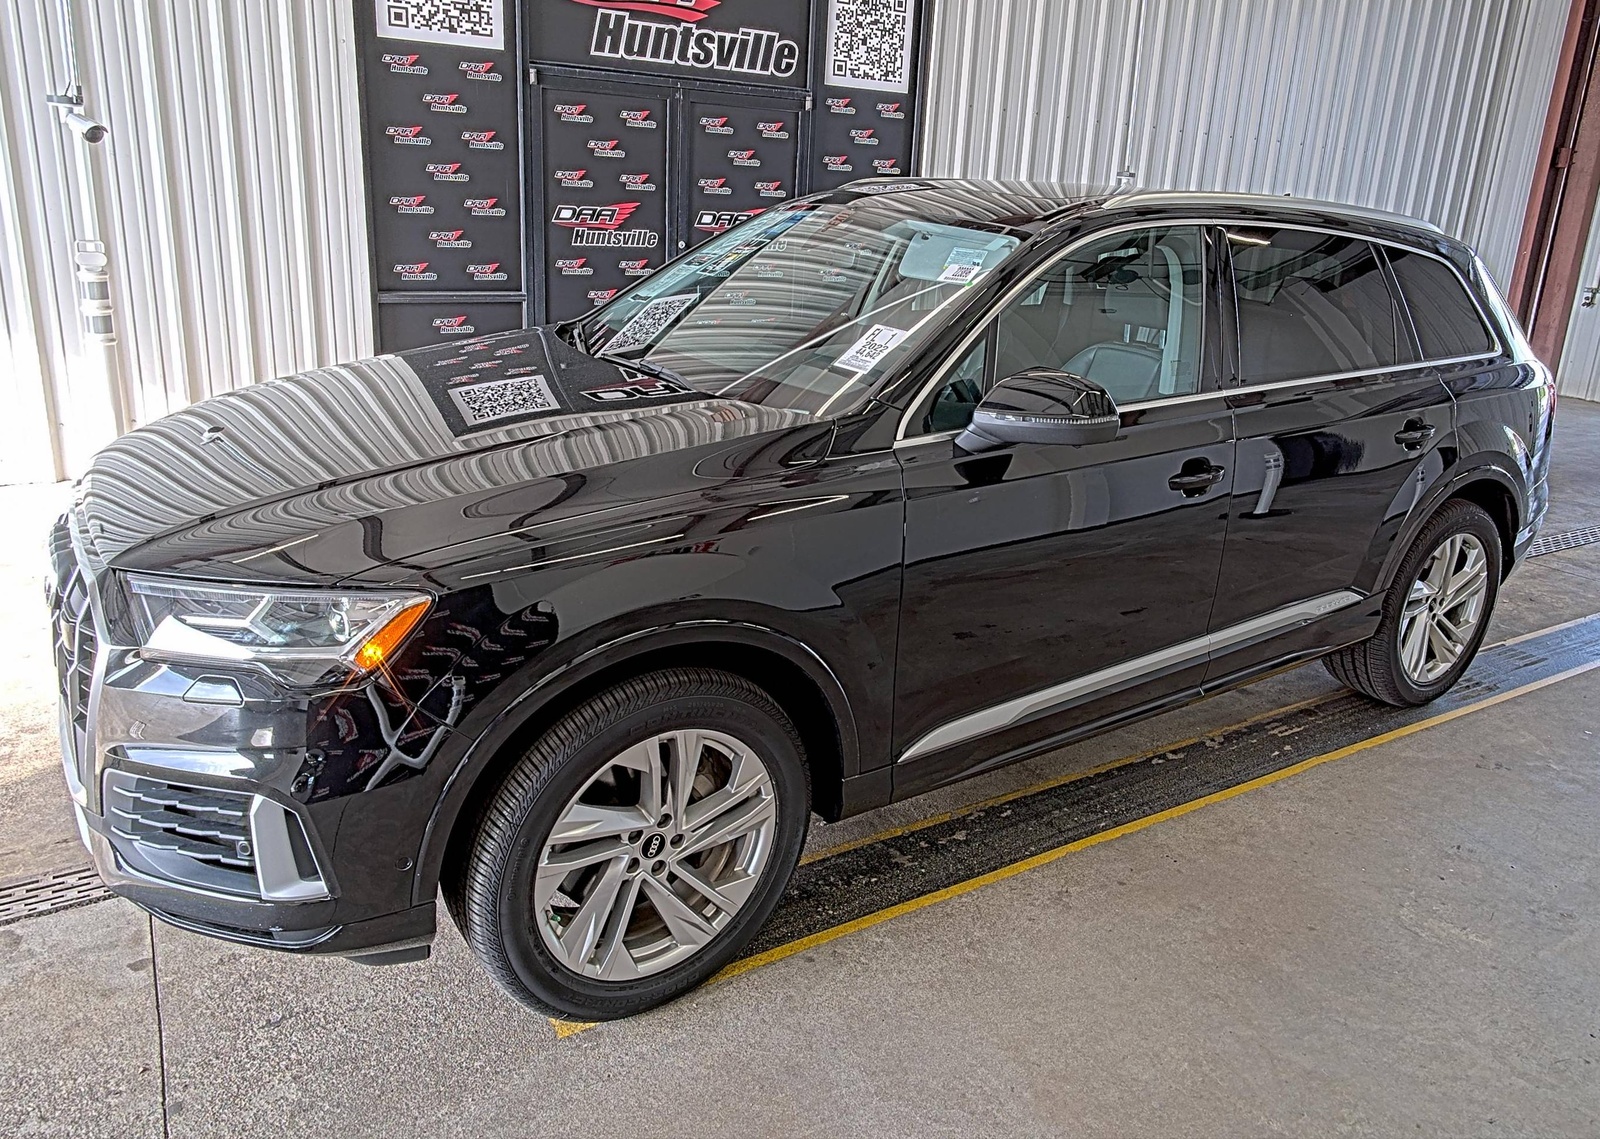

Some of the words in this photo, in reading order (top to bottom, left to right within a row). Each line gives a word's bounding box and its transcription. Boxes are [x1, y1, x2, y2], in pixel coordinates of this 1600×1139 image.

[590, 8, 799, 77] Huntsville
[551, 204, 619, 224] DAA
[572, 228, 659, 248] Huntsville
[862, 341, 889, 353] 2022
